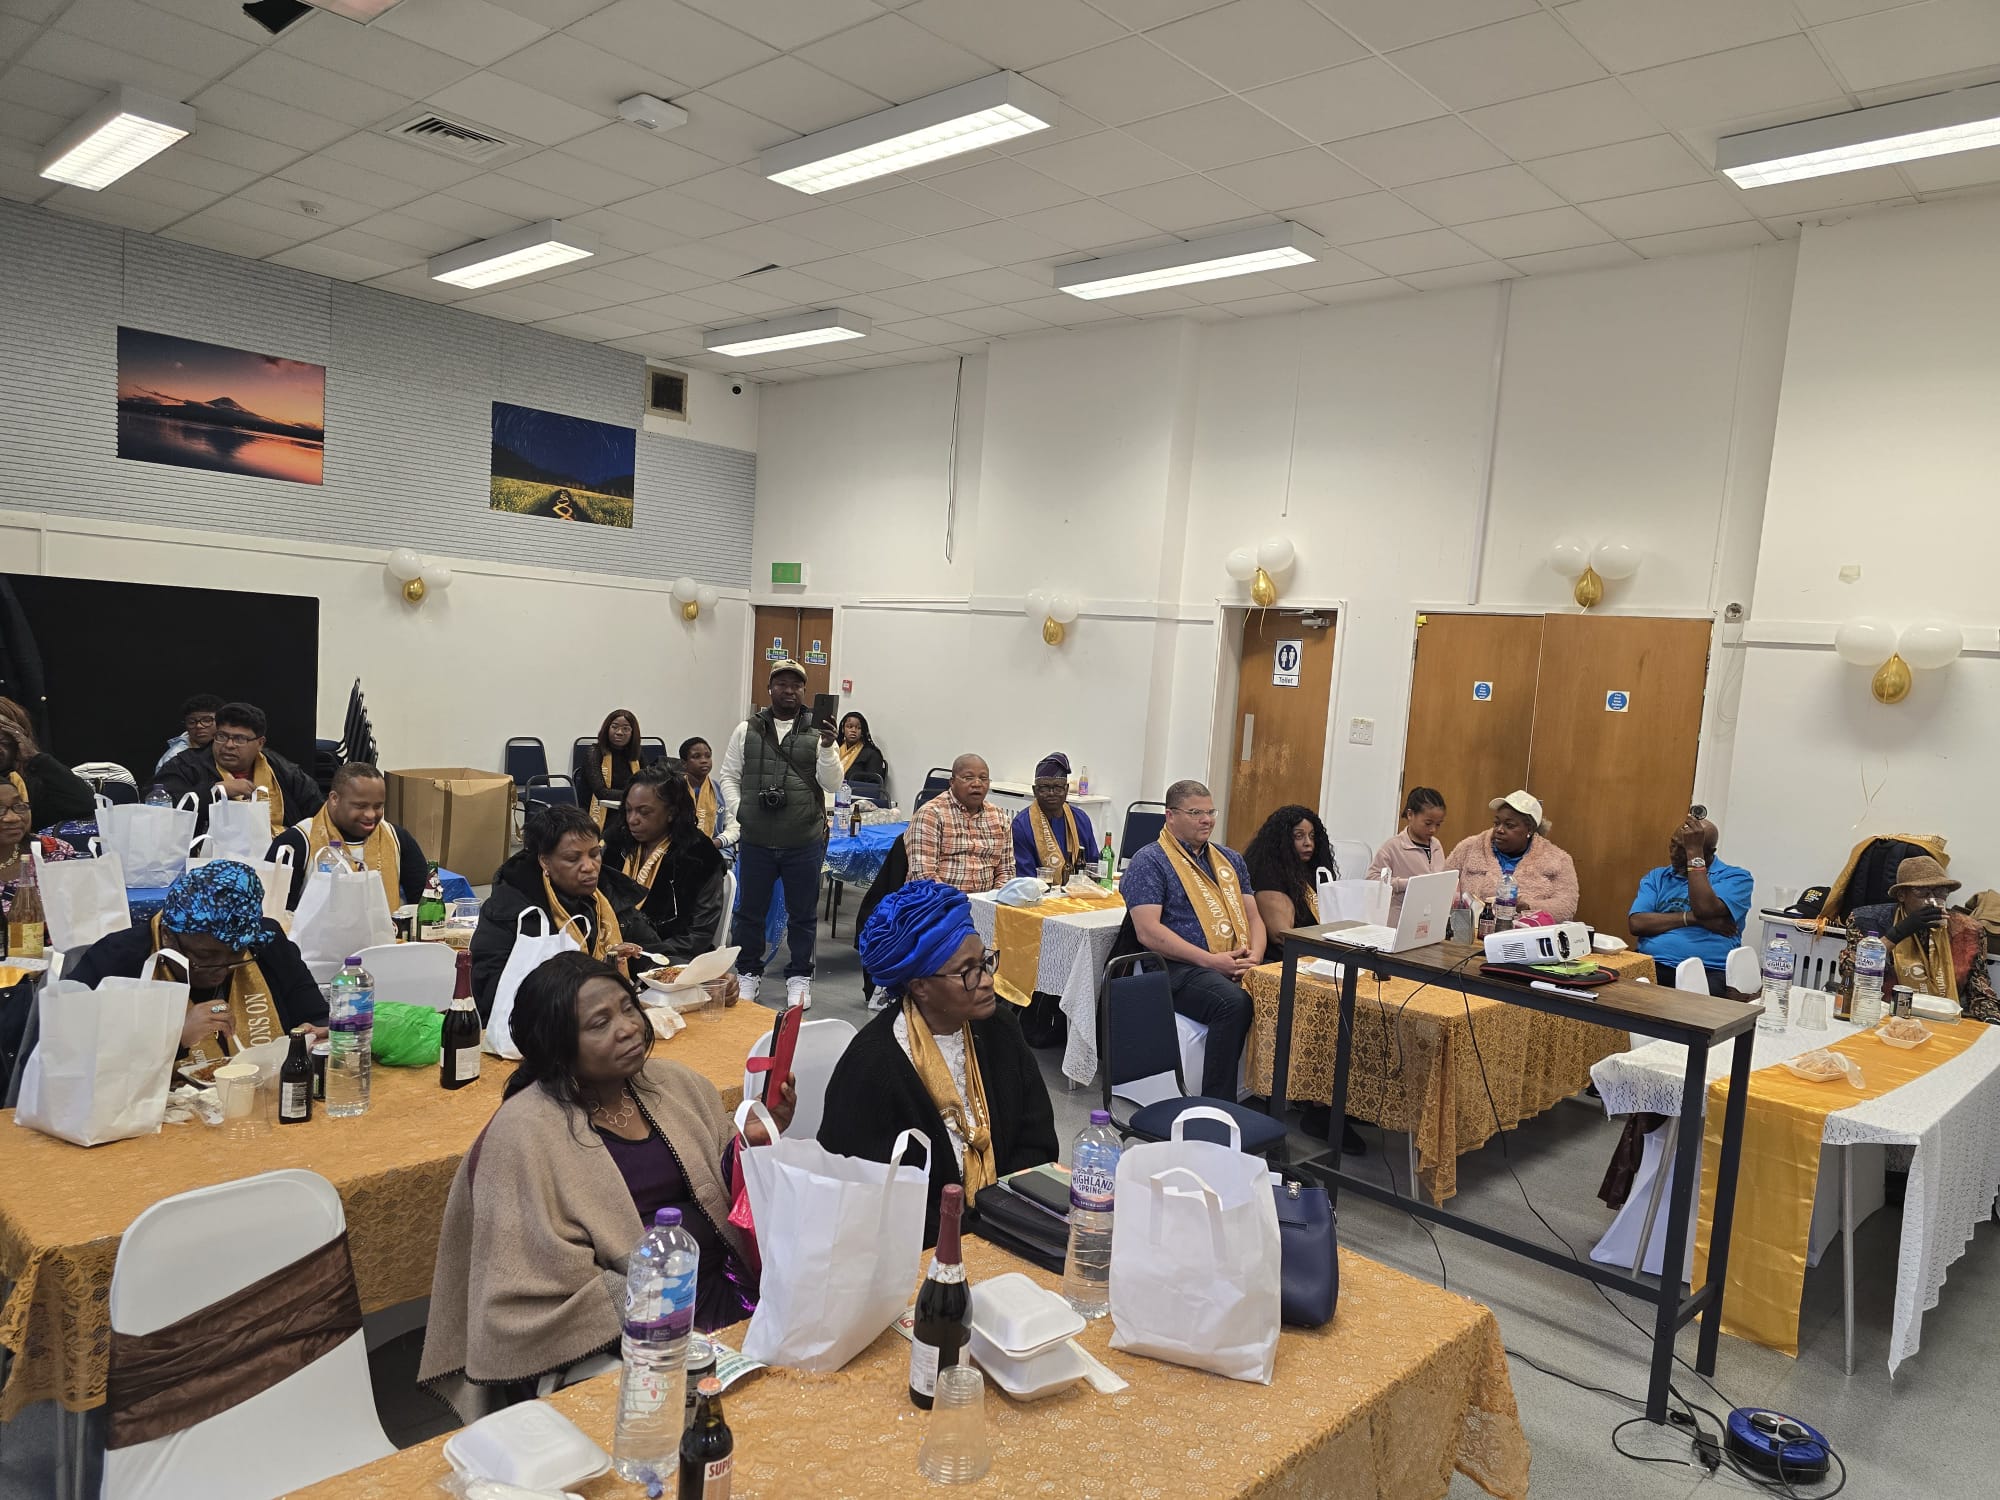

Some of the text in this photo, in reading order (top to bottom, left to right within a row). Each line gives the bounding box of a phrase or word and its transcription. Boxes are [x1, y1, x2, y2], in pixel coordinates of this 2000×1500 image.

[1278, 676, 1294, 684] Toilet
[244, 993, 272, 1047] ONS ON
[1073, 1173, 1114, 1191] HIGHLAND
[1078, 1185, 1102, 1195] SPRING
[708, 1455, 733, 1478] SUPE
